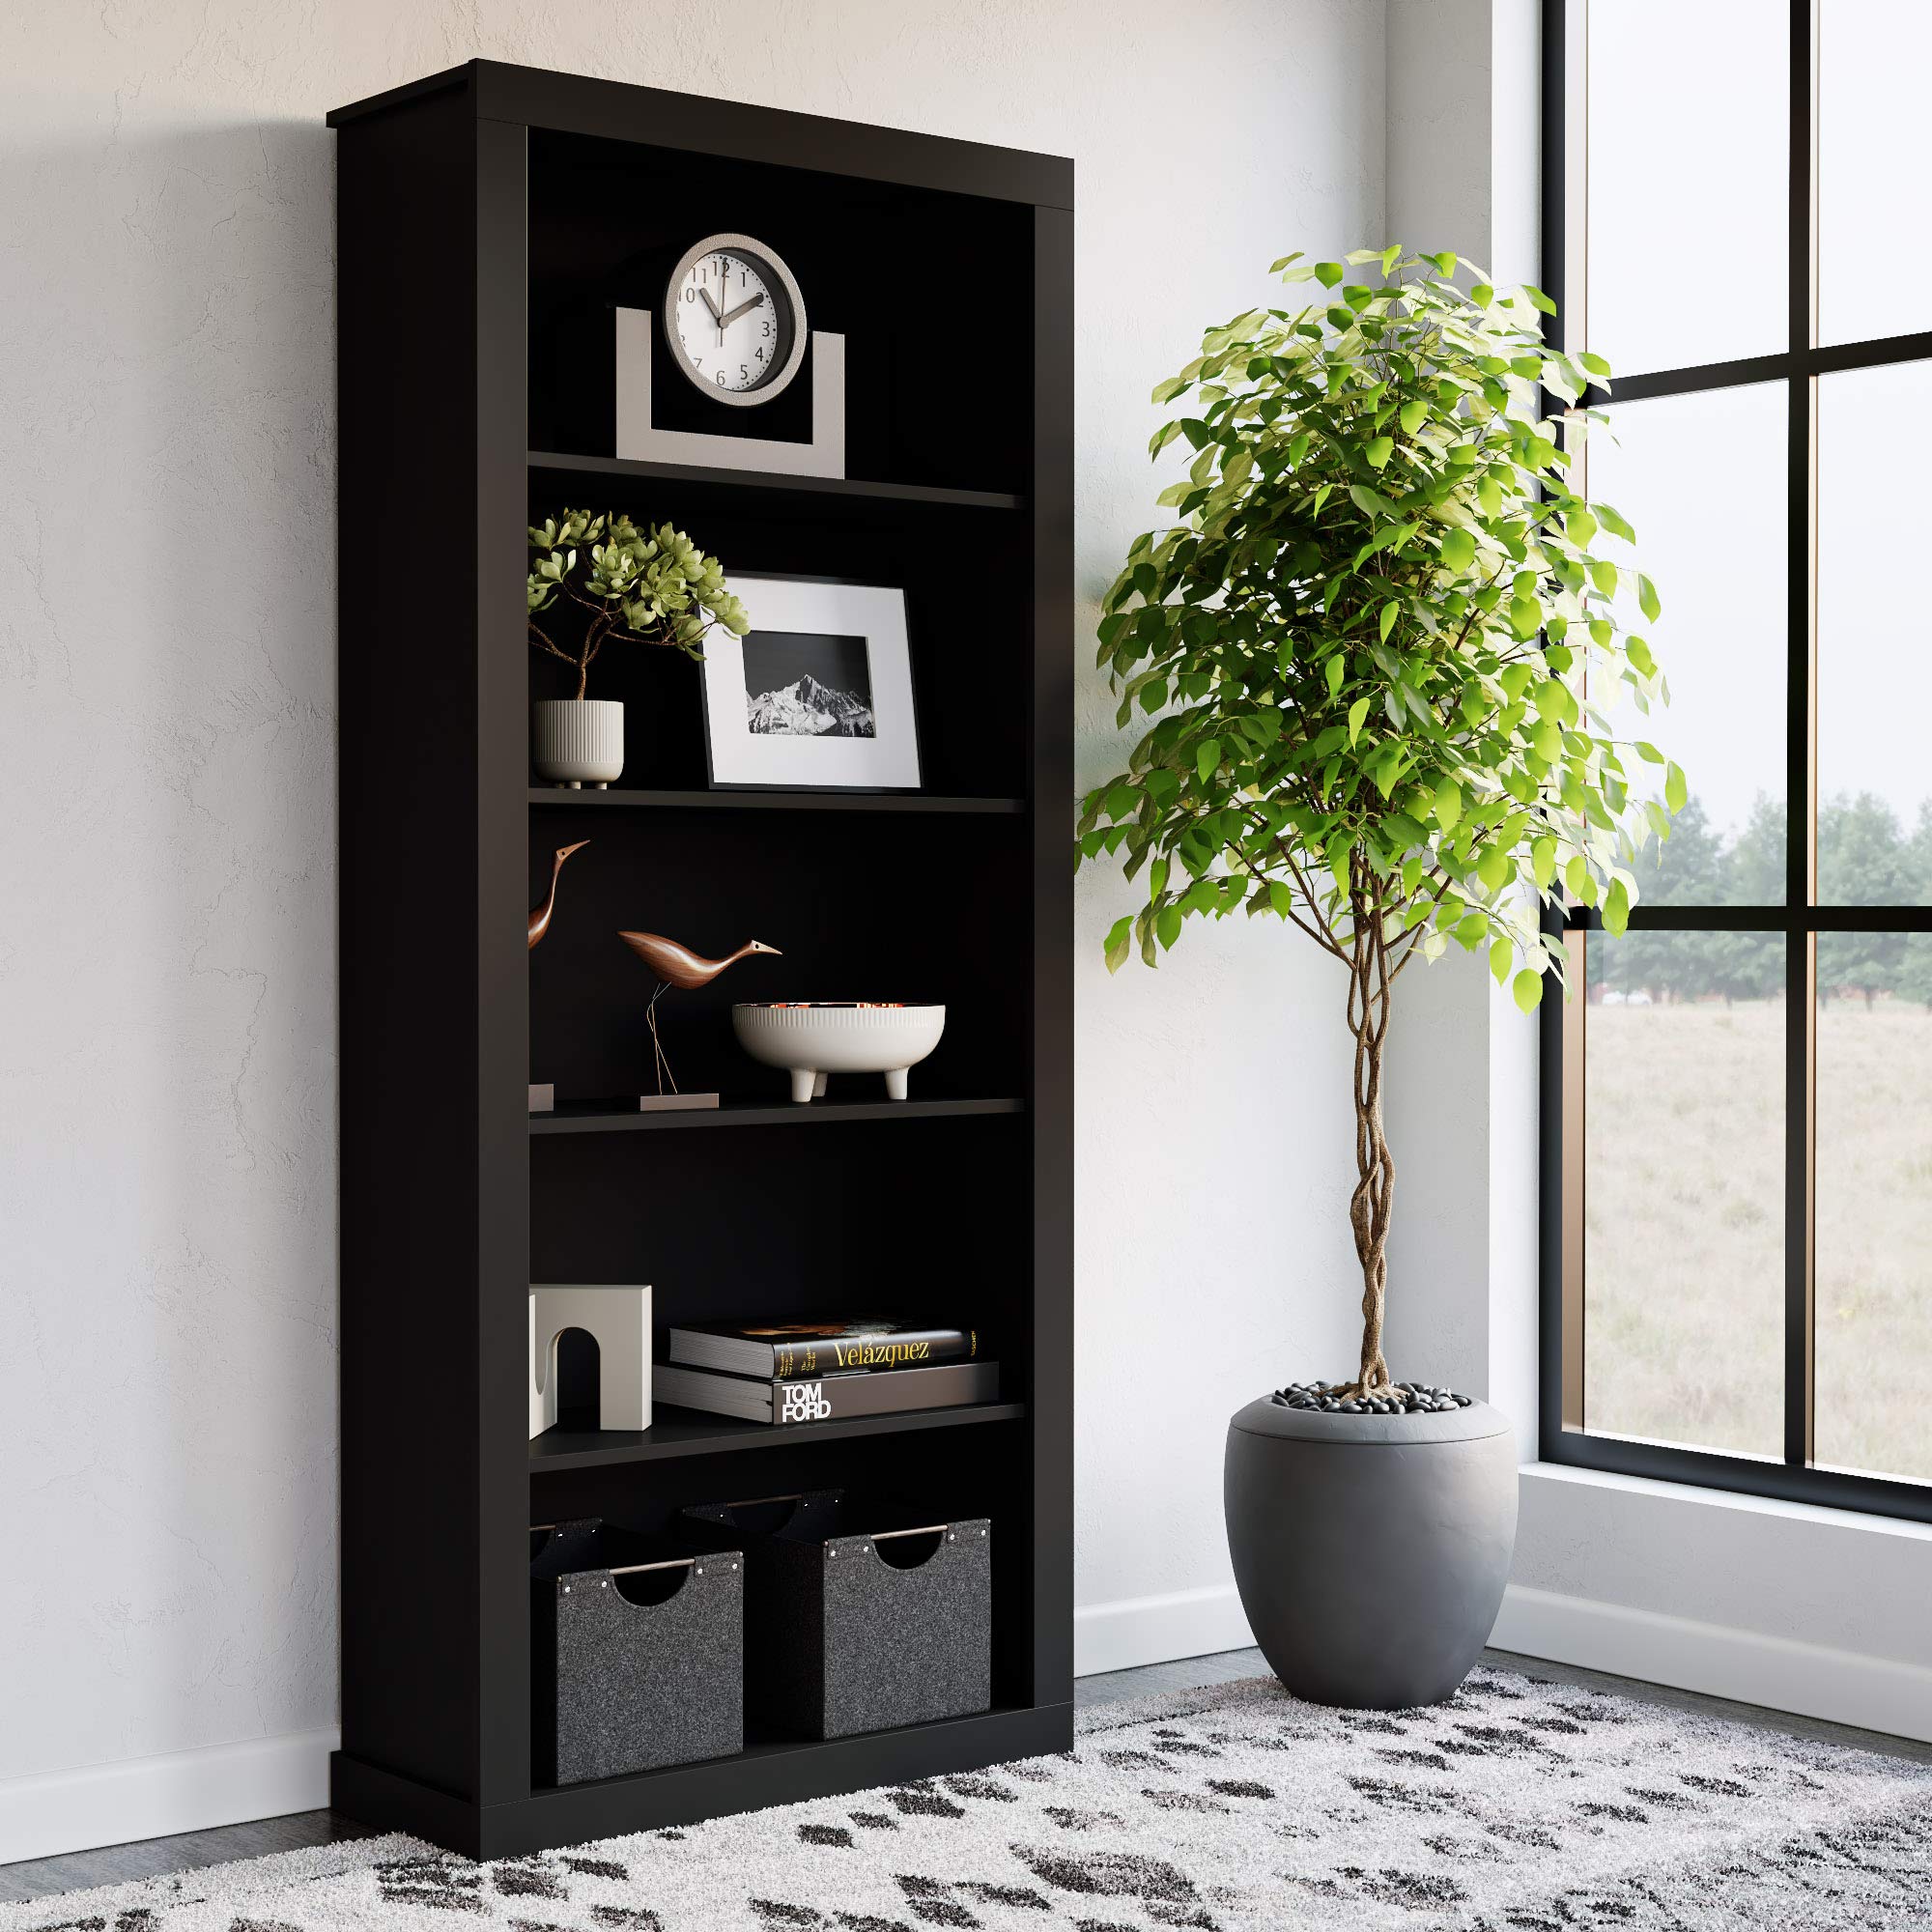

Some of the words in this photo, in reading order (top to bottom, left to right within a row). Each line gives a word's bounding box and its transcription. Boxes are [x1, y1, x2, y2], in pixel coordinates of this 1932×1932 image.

[692, 267, 707, 284] 11
[741, 271, 747, 288] 1
[761, 321, 770, 337] 3
[754, 346, 764, 362] 4
[716, 370, 725, 386] 6
[740, 364, 749, 381] 5
[833, 1340, 929, 1368] Velázquez
[781, 1382, 822, 1405] TOM
[781, 1400, 832, 1423] FORD
